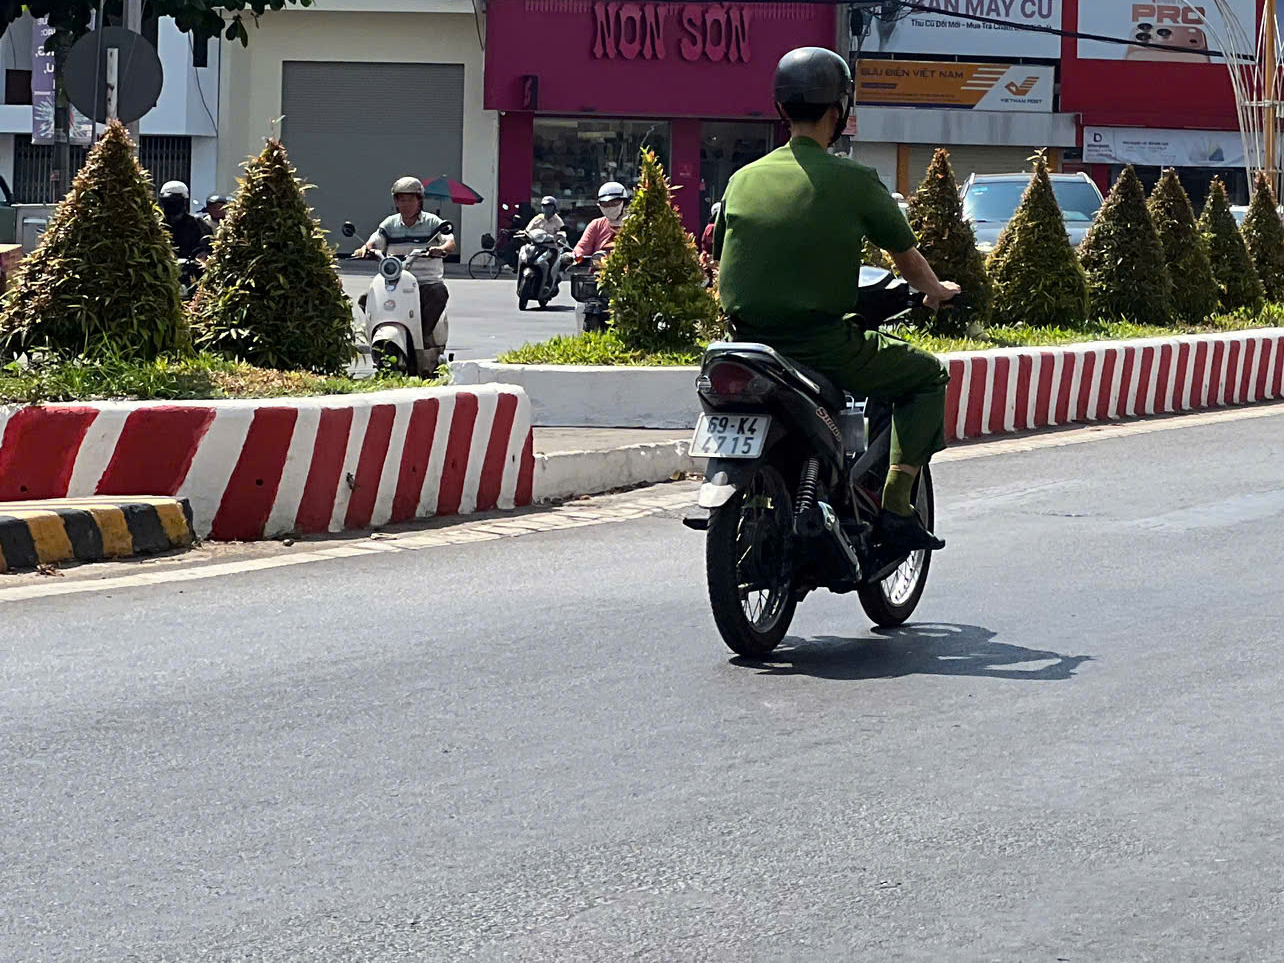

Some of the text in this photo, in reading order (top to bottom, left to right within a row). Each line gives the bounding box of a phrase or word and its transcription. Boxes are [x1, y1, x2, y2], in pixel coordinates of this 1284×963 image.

[1132, 4, 1206, 24] PRO
[707, 417, 758, 435] 69-K4
[702, 436, 754, 454] 4715
